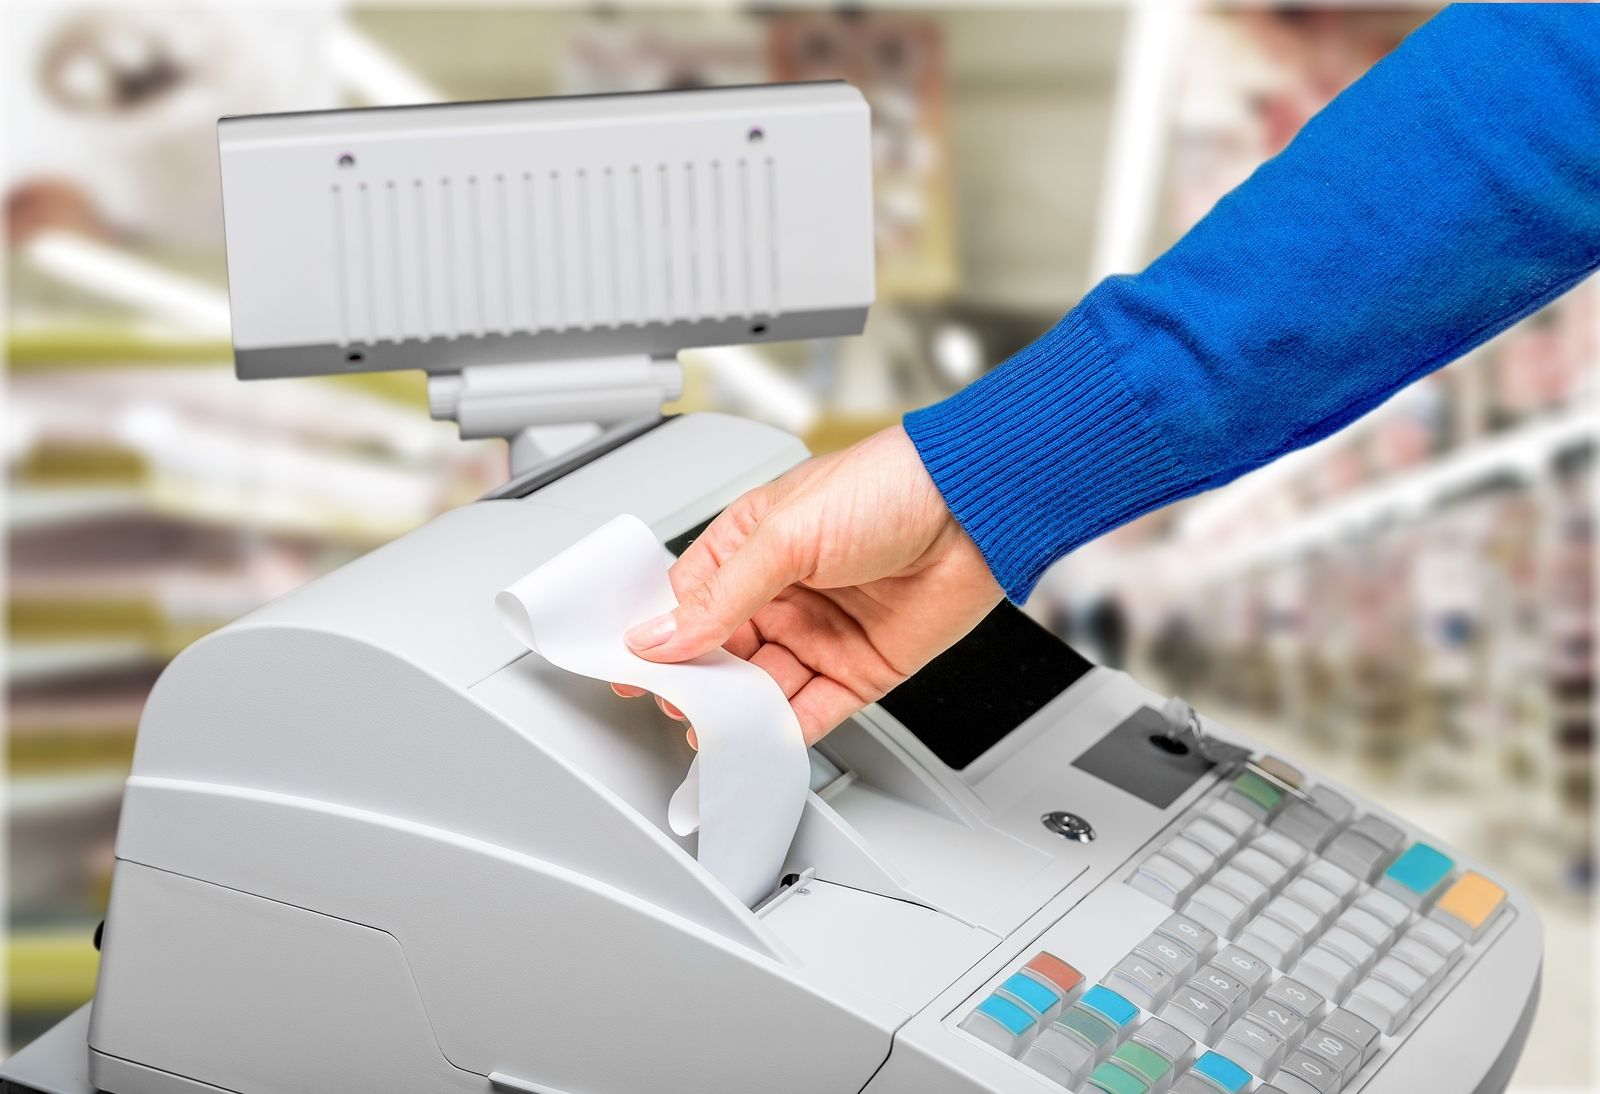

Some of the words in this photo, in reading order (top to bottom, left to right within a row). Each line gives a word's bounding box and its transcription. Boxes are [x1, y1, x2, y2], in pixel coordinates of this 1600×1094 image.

[1178, 923, 1198, 937] 9
[1158, 945, 1178, 959] 8
[1231, 956, 1251, 970] 6
[1133, 965, 1153, 979] 7
[1208, 975, 1229, 990] 5
[1286, 987, 1306, 1000] 3
[1189, 997, 1209, 1010] 4
[1268, 1009, 1289, 1025] 2
[1245, 1030, 1266, 1042] 1
[1318, 1037, 1343, 1056] 00
[1302, 1062, 1322, 1076] 0
